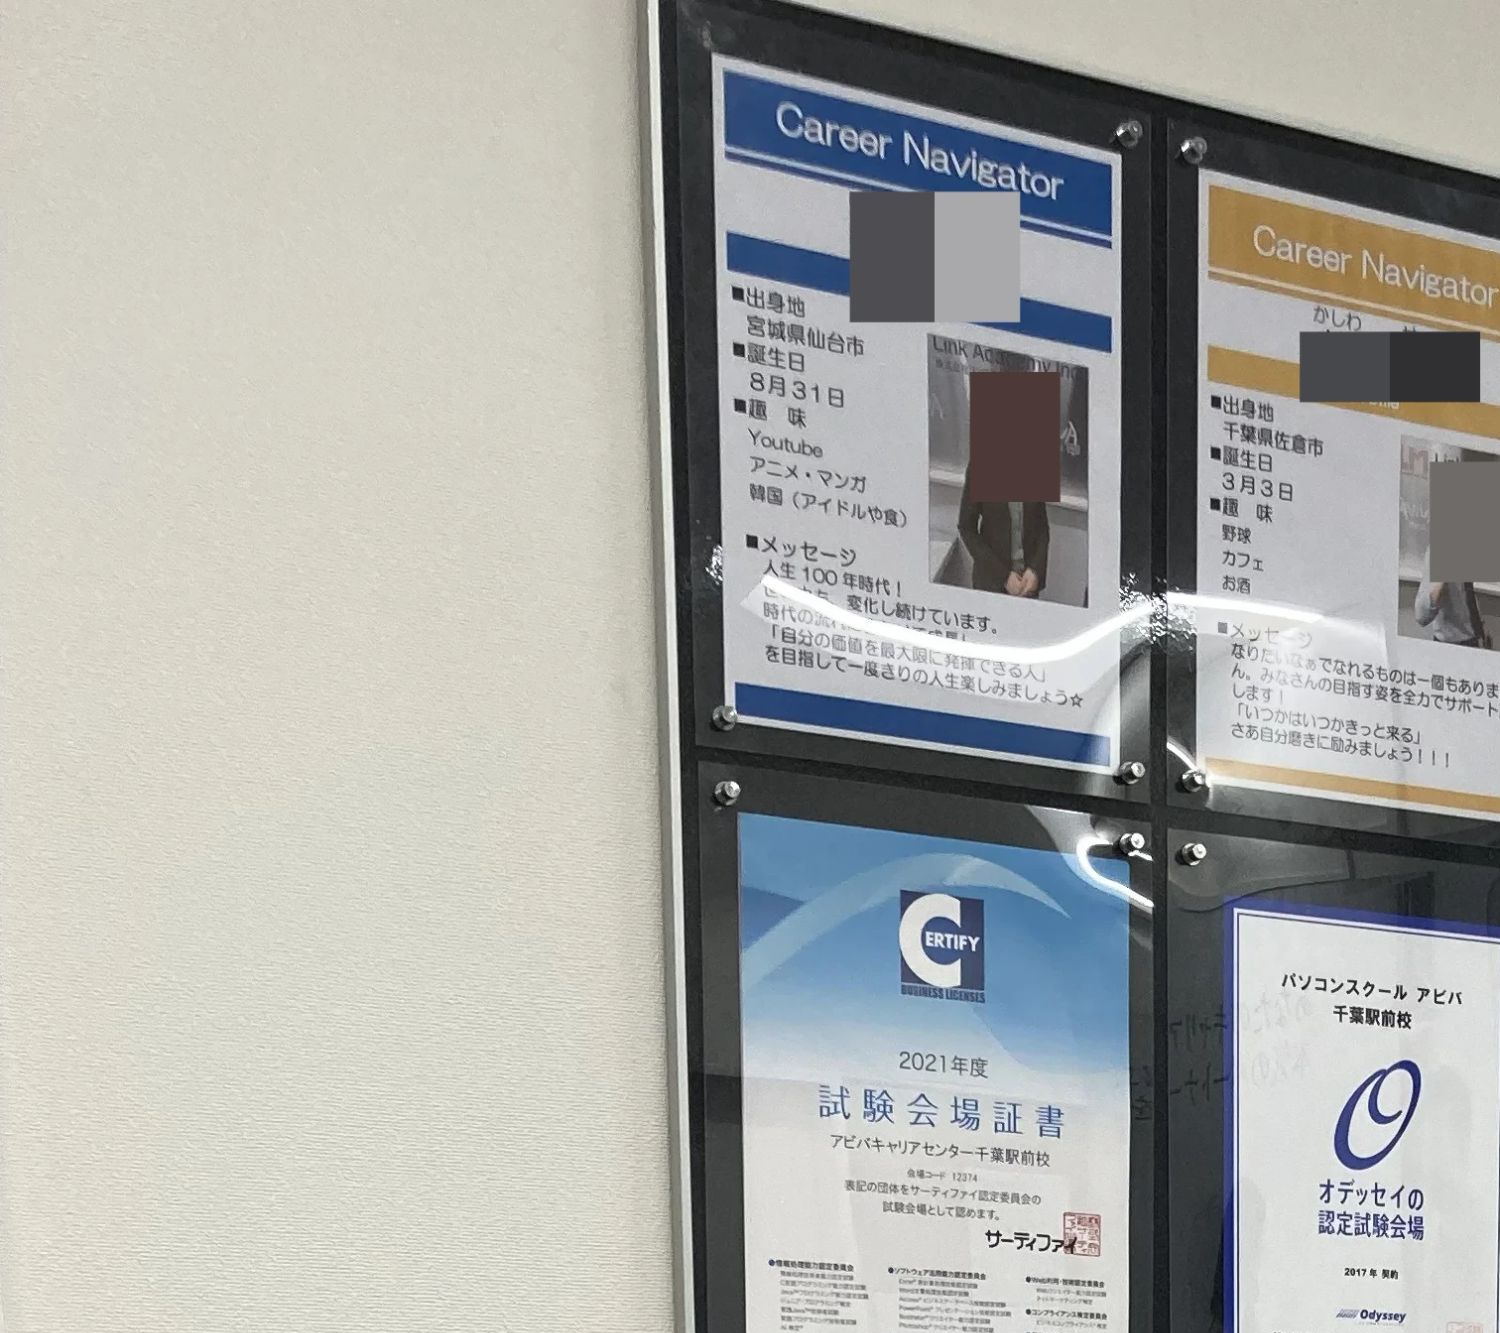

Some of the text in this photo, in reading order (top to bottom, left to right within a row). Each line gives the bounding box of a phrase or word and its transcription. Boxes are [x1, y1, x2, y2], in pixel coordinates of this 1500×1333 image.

[776, 102, 1064, 201] Career Navigator
[1253, 225, 1500, 308] Career Navigator
[746, 287, 805, 317] 出身地
[747, 316, 864, 356] 宮城県仙台市
[748, 344, 805, 372] 誕生日
[1223, 395, 1274, 421] 出身地
[749, 429, 823, 459] Youtube
[1223, 422, 1324, 456] 千葉県佐倉市
[750, 456, 866, 493] アニメ・マンガ
[1223, 447, 1273, 472] 誕生日
[1222, 524, 1251, 545] 野球
[761, 535, 857, 566] メッセージ
[1222, 550, 1264, 572] カフェ
[1222, 576, 1251, 595] お酒
[1417, 986, 1463, 1005] アビバ
[1333, 1005, 1413, 1030] 千葉駅前校
[899, 1052, 989, 1079] 2021年度
[818, 1084, 1066, 1139] 試験会場証書
[830, 1134, 1050, 1168] アビバキャリアセンター千葉駅前校
[1319, 1178, 1424, 1211] オデッセイの
[1318, 1210, 1424, 1241] 認定試験会場
[985, 1229, 1078, 1255] サーティファイ
[1360, 1309, 1407, 1323] Odyssey
